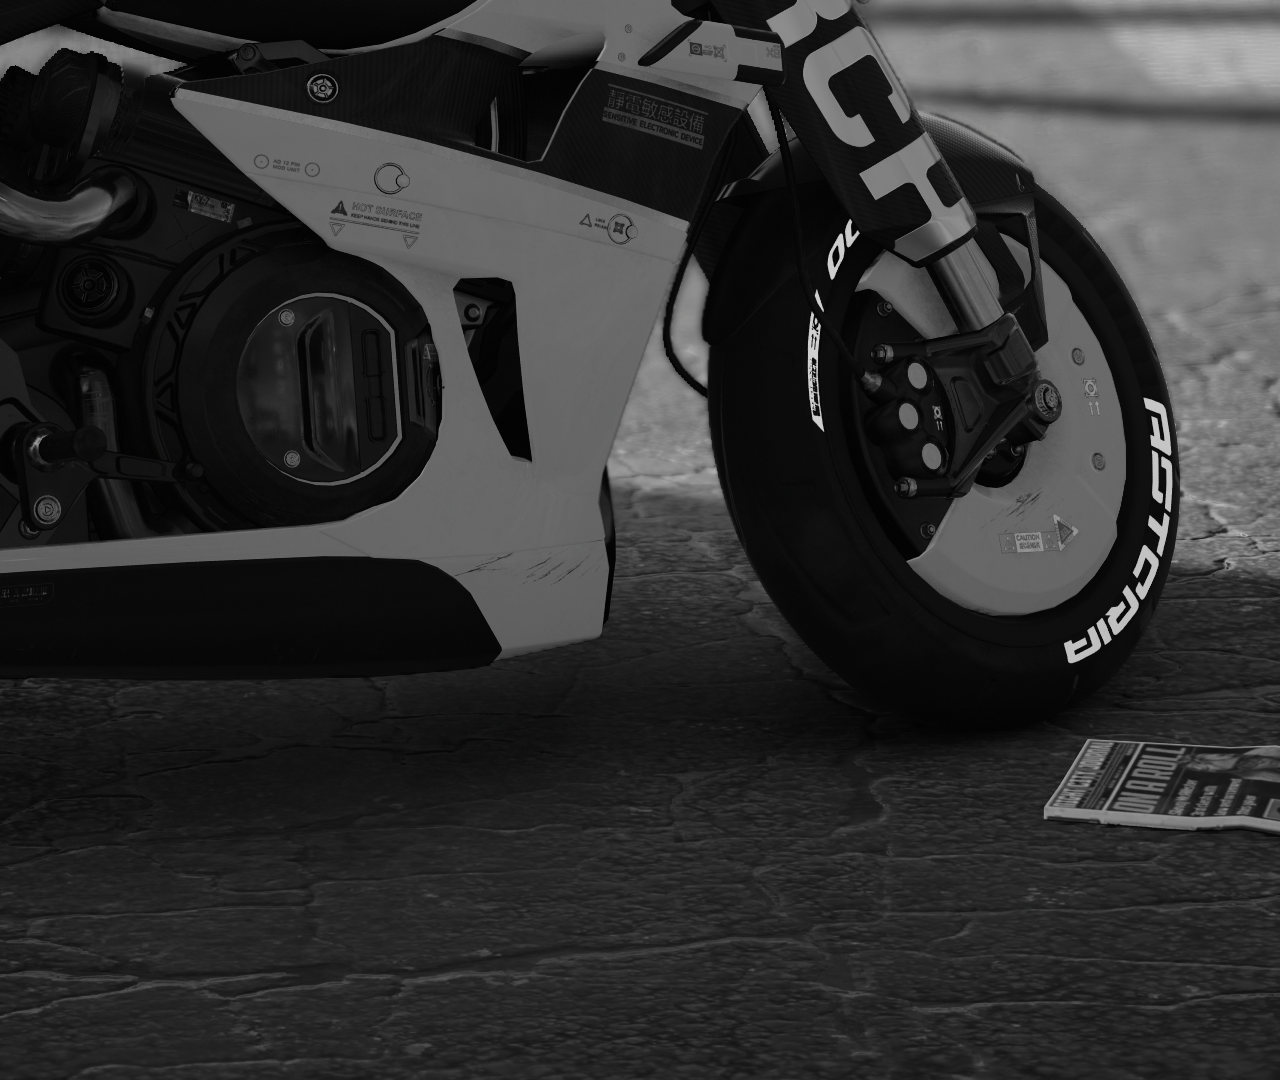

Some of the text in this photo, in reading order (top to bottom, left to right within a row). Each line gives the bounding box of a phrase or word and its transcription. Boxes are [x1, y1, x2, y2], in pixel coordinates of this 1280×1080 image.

[640, 120, 679, 138] ELECTRONIC
[680, 132, 703, 146] DEVICE
[352, 201, 374, 213] HOT
[1015, 533, 1040, 541] CAUTION
[1131, 746, 1187, 781] ROLL
[1124, 779, 1168, 793] A
[1112, 791, 1162, 814] ON
